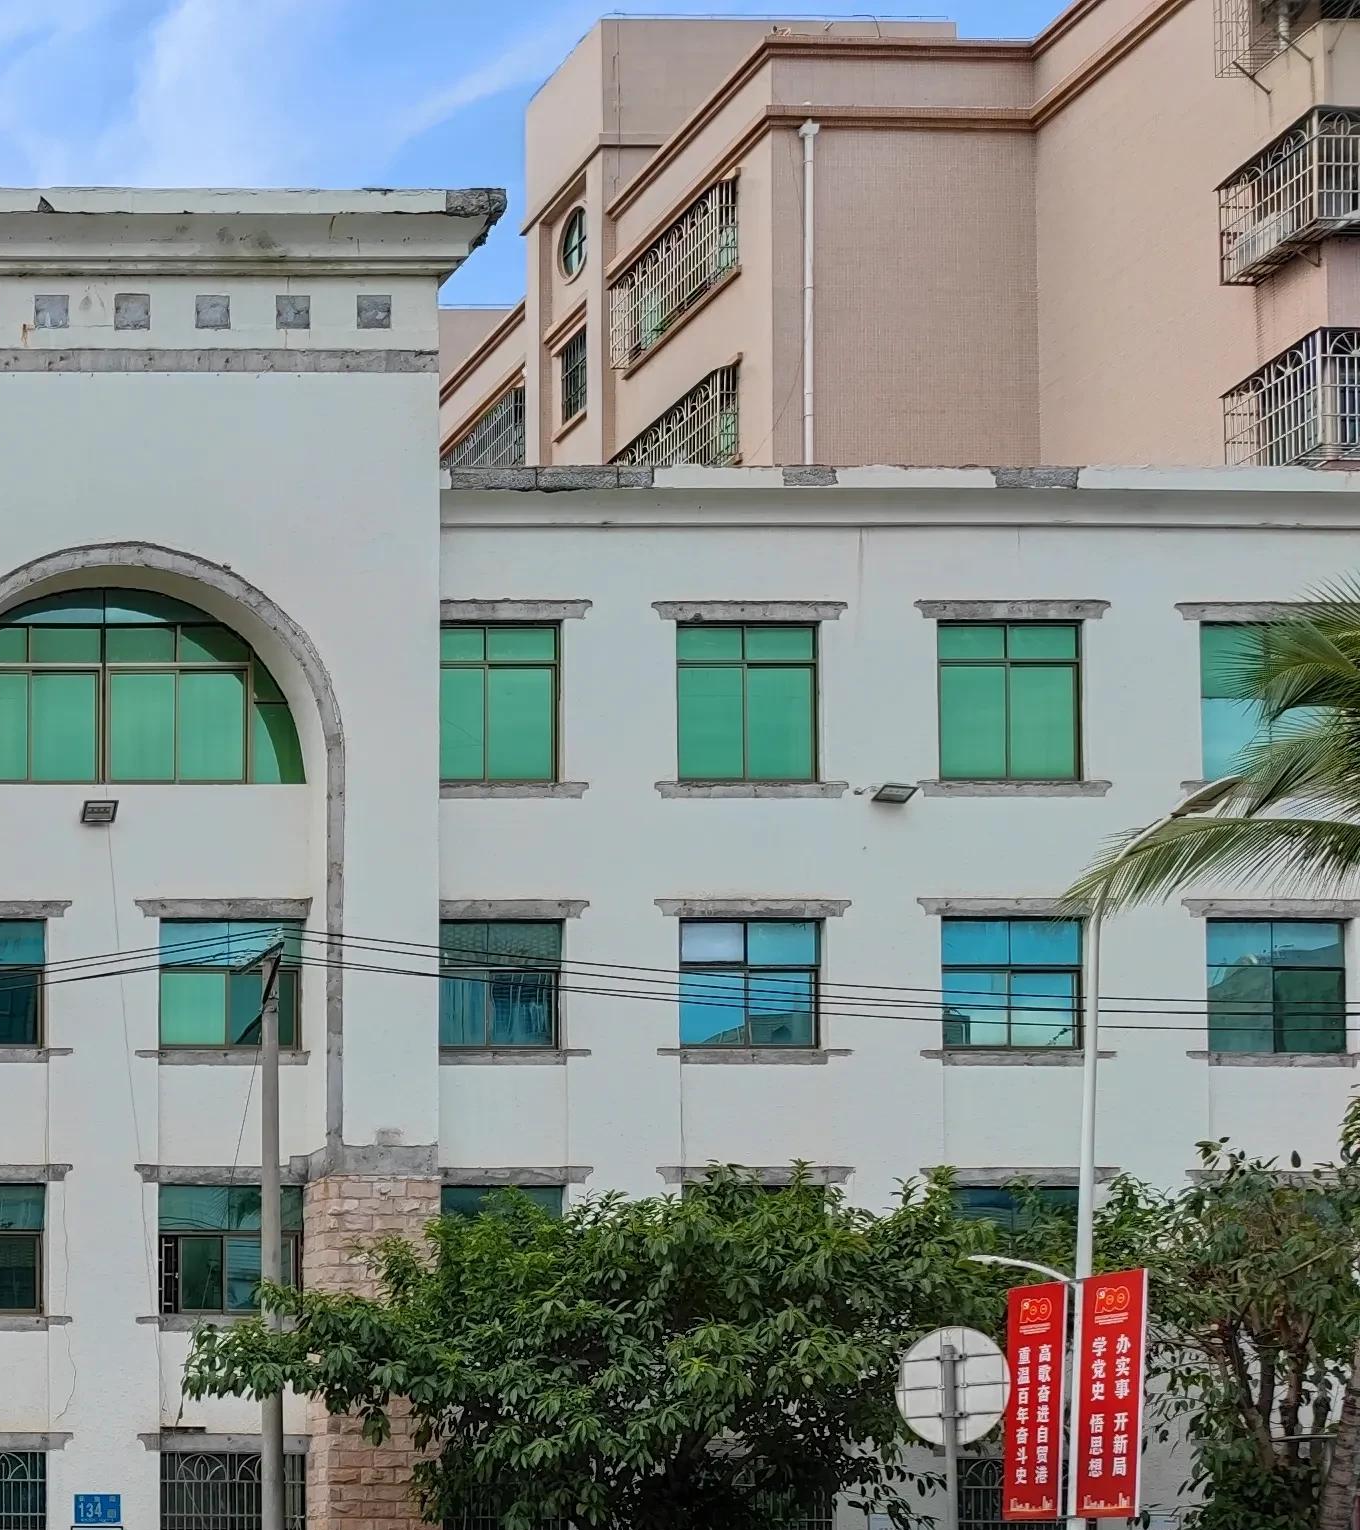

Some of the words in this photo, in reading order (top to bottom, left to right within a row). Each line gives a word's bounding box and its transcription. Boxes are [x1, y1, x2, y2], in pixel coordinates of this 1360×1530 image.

[1091, 1336, 1108, 1402] 学党史
[1113, 1333, 1132, 1400] 办实事
[1014, 1348, 1031, 1485] 重温百年奋斗史
[1034, 1343, 1052, 1484] 高歌奋进自贸港
[1088, 1414, 1105, 1478] 悟思想
[1112, 1413, 1130, 1477] 开新局
[79, 1502, 102, 1518] 134
